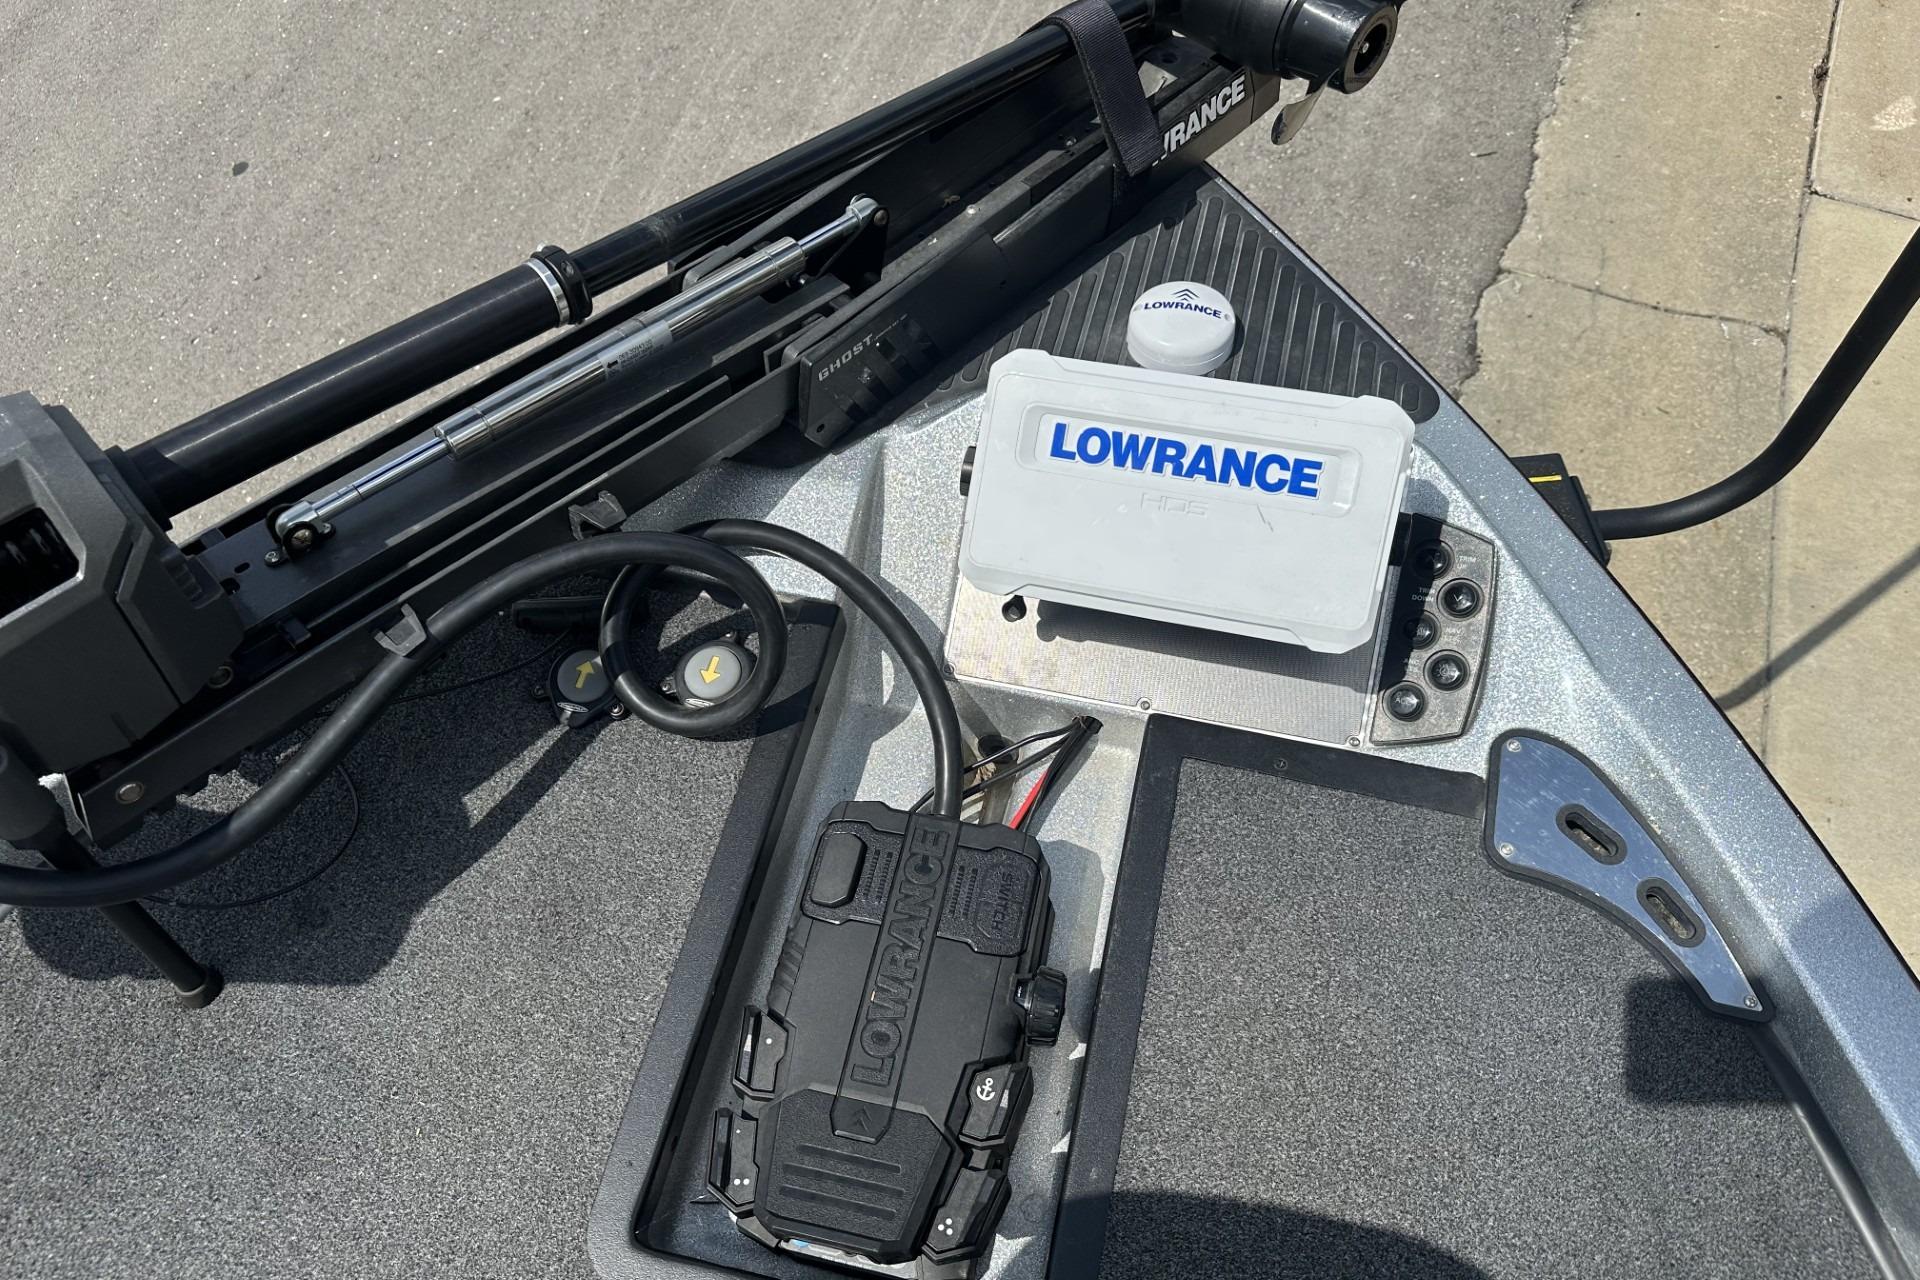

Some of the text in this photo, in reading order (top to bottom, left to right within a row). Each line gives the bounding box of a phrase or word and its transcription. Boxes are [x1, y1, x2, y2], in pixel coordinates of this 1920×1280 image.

[1152, 75, 1246, 166] RANCE
[1143, 301, 1222, 319] LOWRANCE
[818, 333, 873, 382] GHOST
[1050, 422, 1324, 498] LOWRANCE
[851, 827, 951, 1086] LOWRANCE
